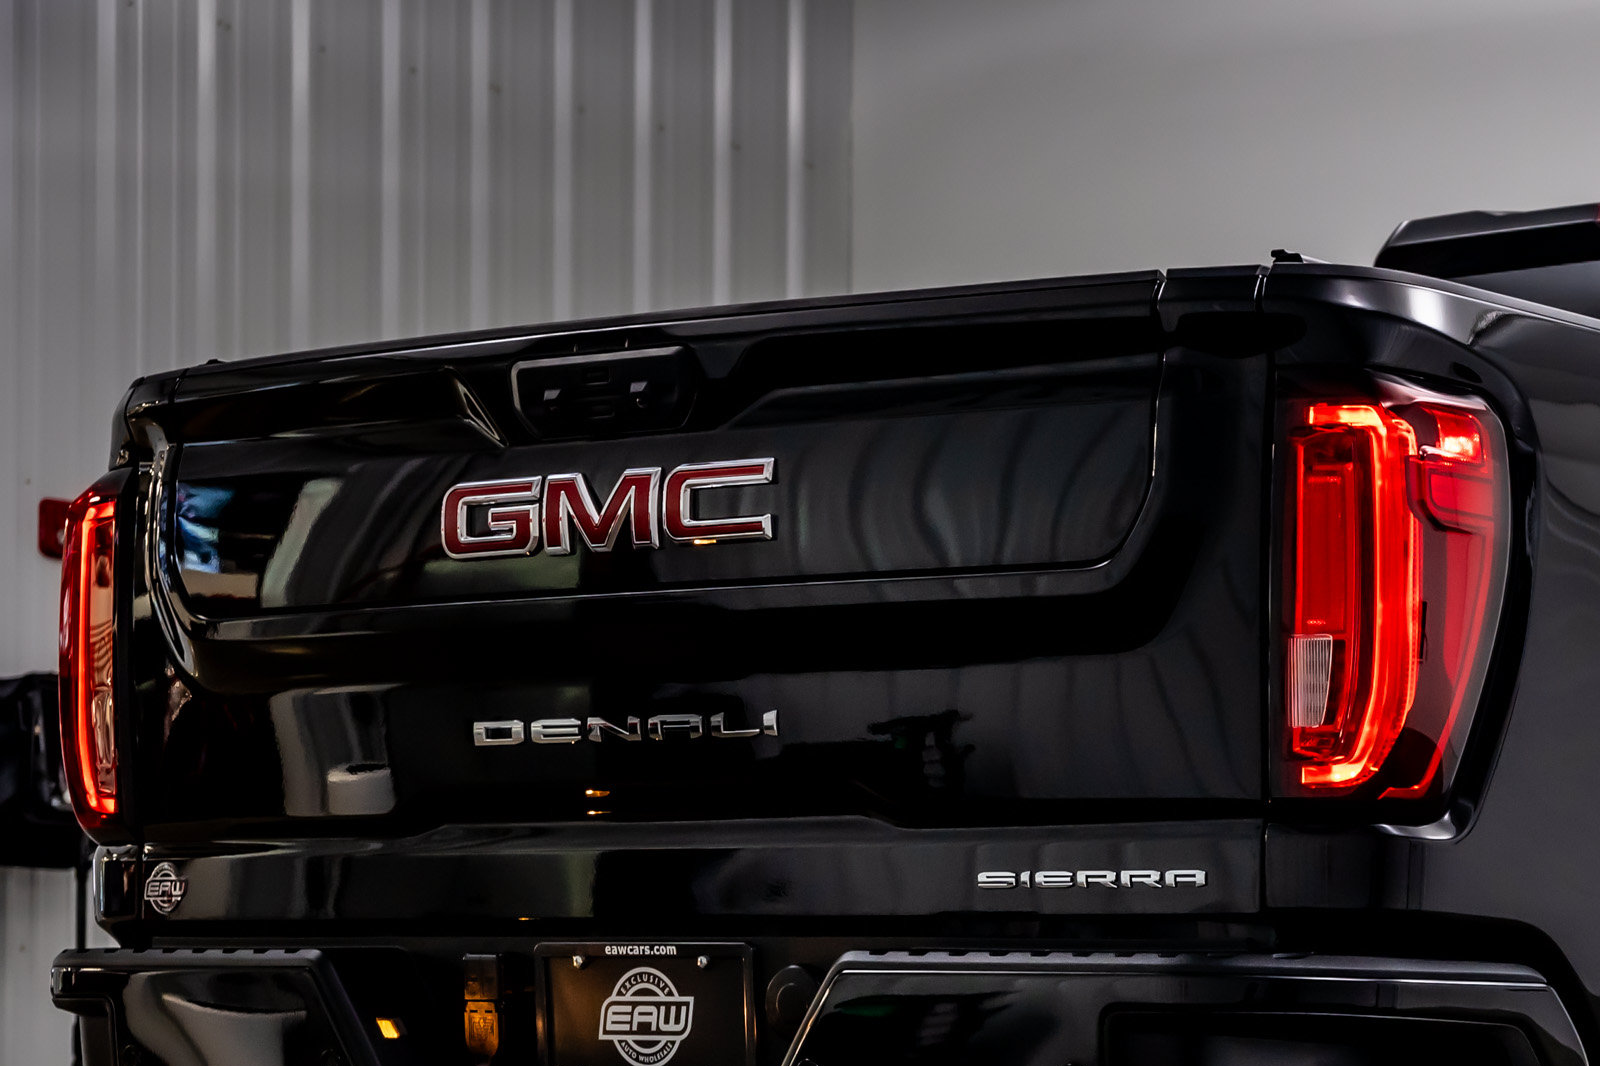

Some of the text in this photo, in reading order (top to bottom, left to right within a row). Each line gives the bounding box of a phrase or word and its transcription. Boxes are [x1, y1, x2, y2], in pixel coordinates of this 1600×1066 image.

[440, 457, 775, 560] GMC
[472, 708, 779, 747] DENALI
[147, 881, 185, 896] EAW
[977, 869, 1207, 889] SIERRA
[604, 944, 677, 956] eawcars.com
[620, 973, 670, 995] EXCLUSIVE
[605, 1004, 687, 1031] EAW
[620, 1041, 673, 1063] AUTO WHOLESALE
